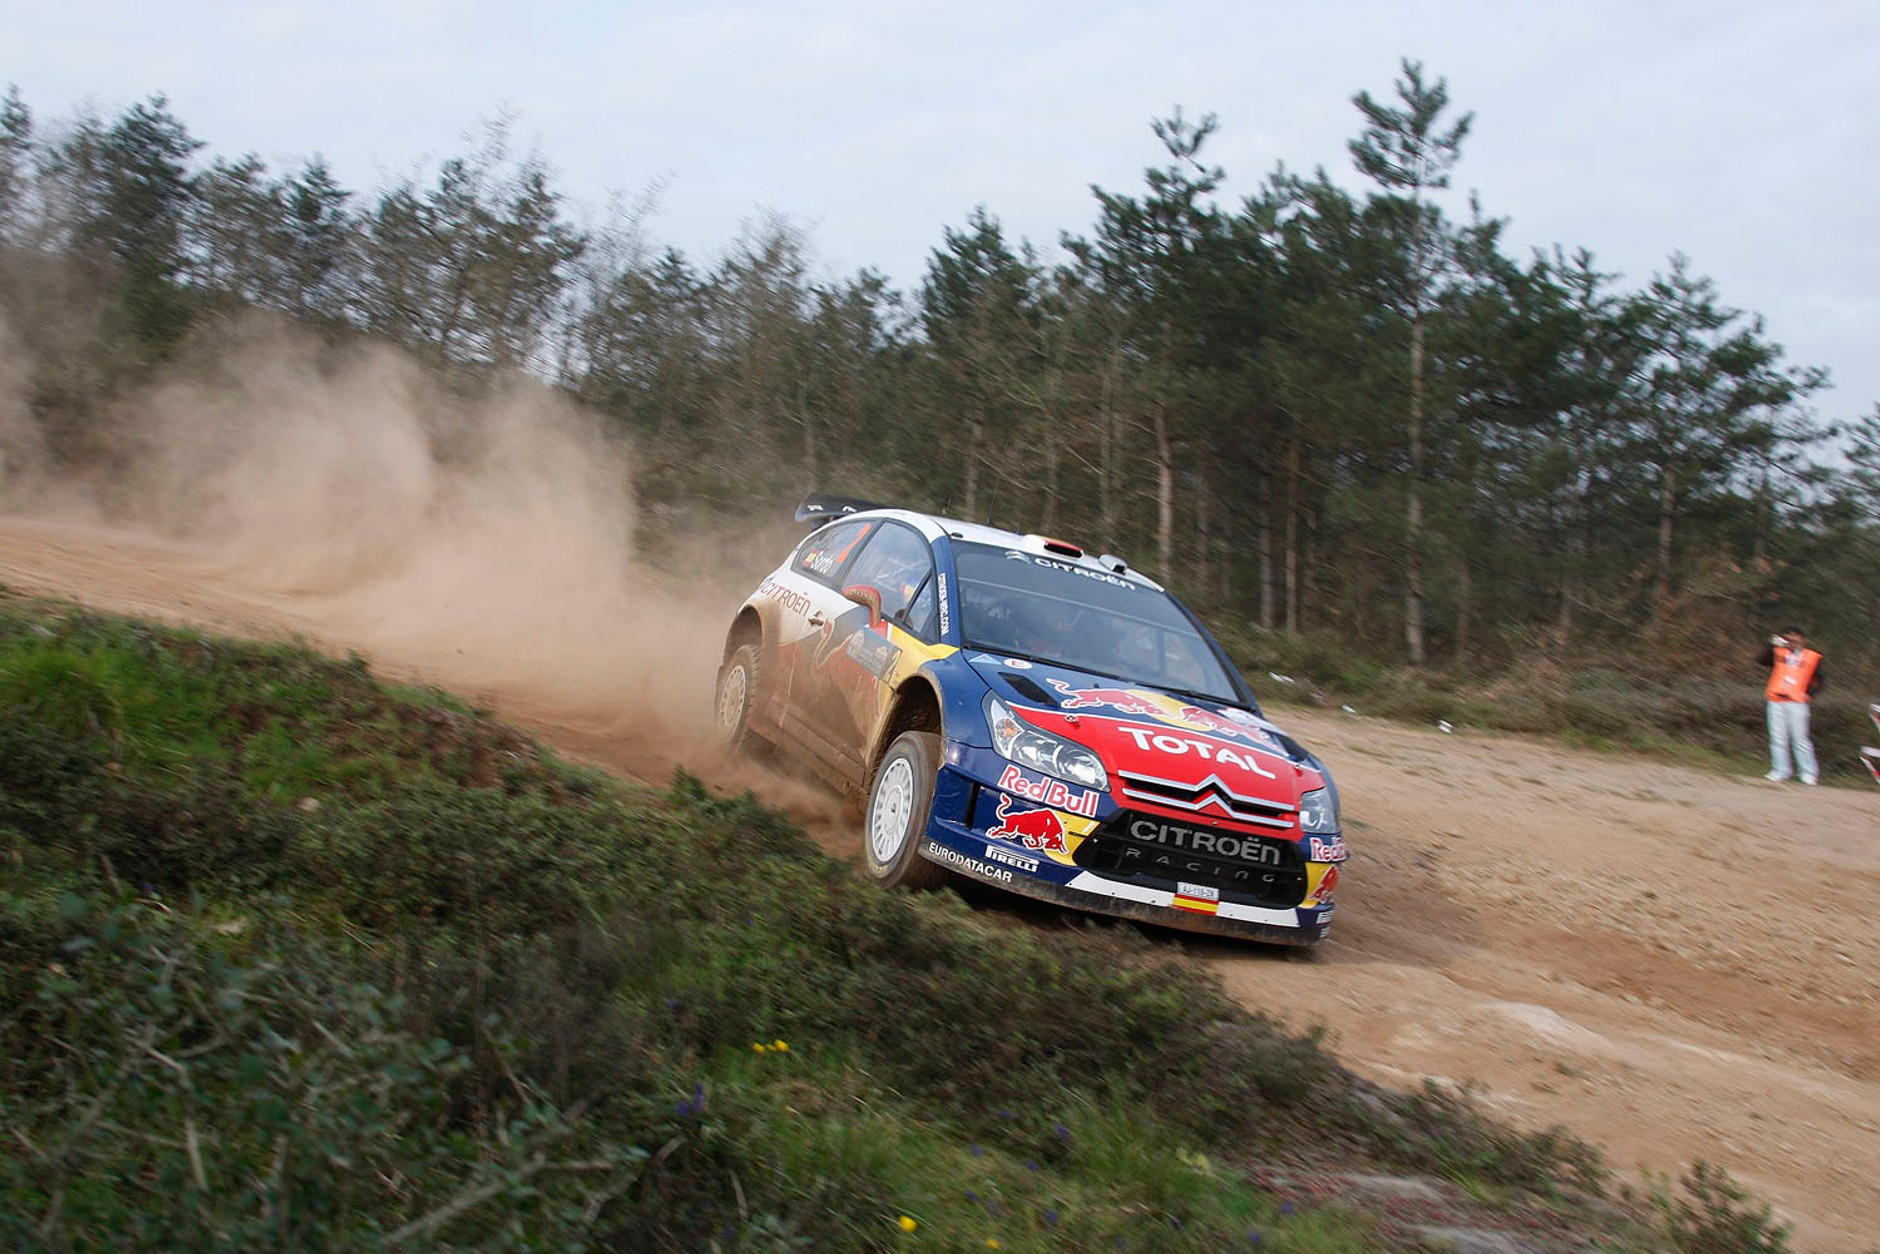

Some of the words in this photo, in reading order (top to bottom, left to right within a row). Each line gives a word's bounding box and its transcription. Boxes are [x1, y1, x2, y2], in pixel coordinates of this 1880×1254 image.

[1118, 726, 1276, 780] TOTAL
[998, 764, 1049, 801] Red
[1048, 782, 1100, 818] Bull
[928, 841, 1013, 883] EURODATACAR
[985, 845, 1039, 873] PIRELLI
[1130, 820, 1281, 866] CITROËN
[1125, 848, 1275, 883] RACING
